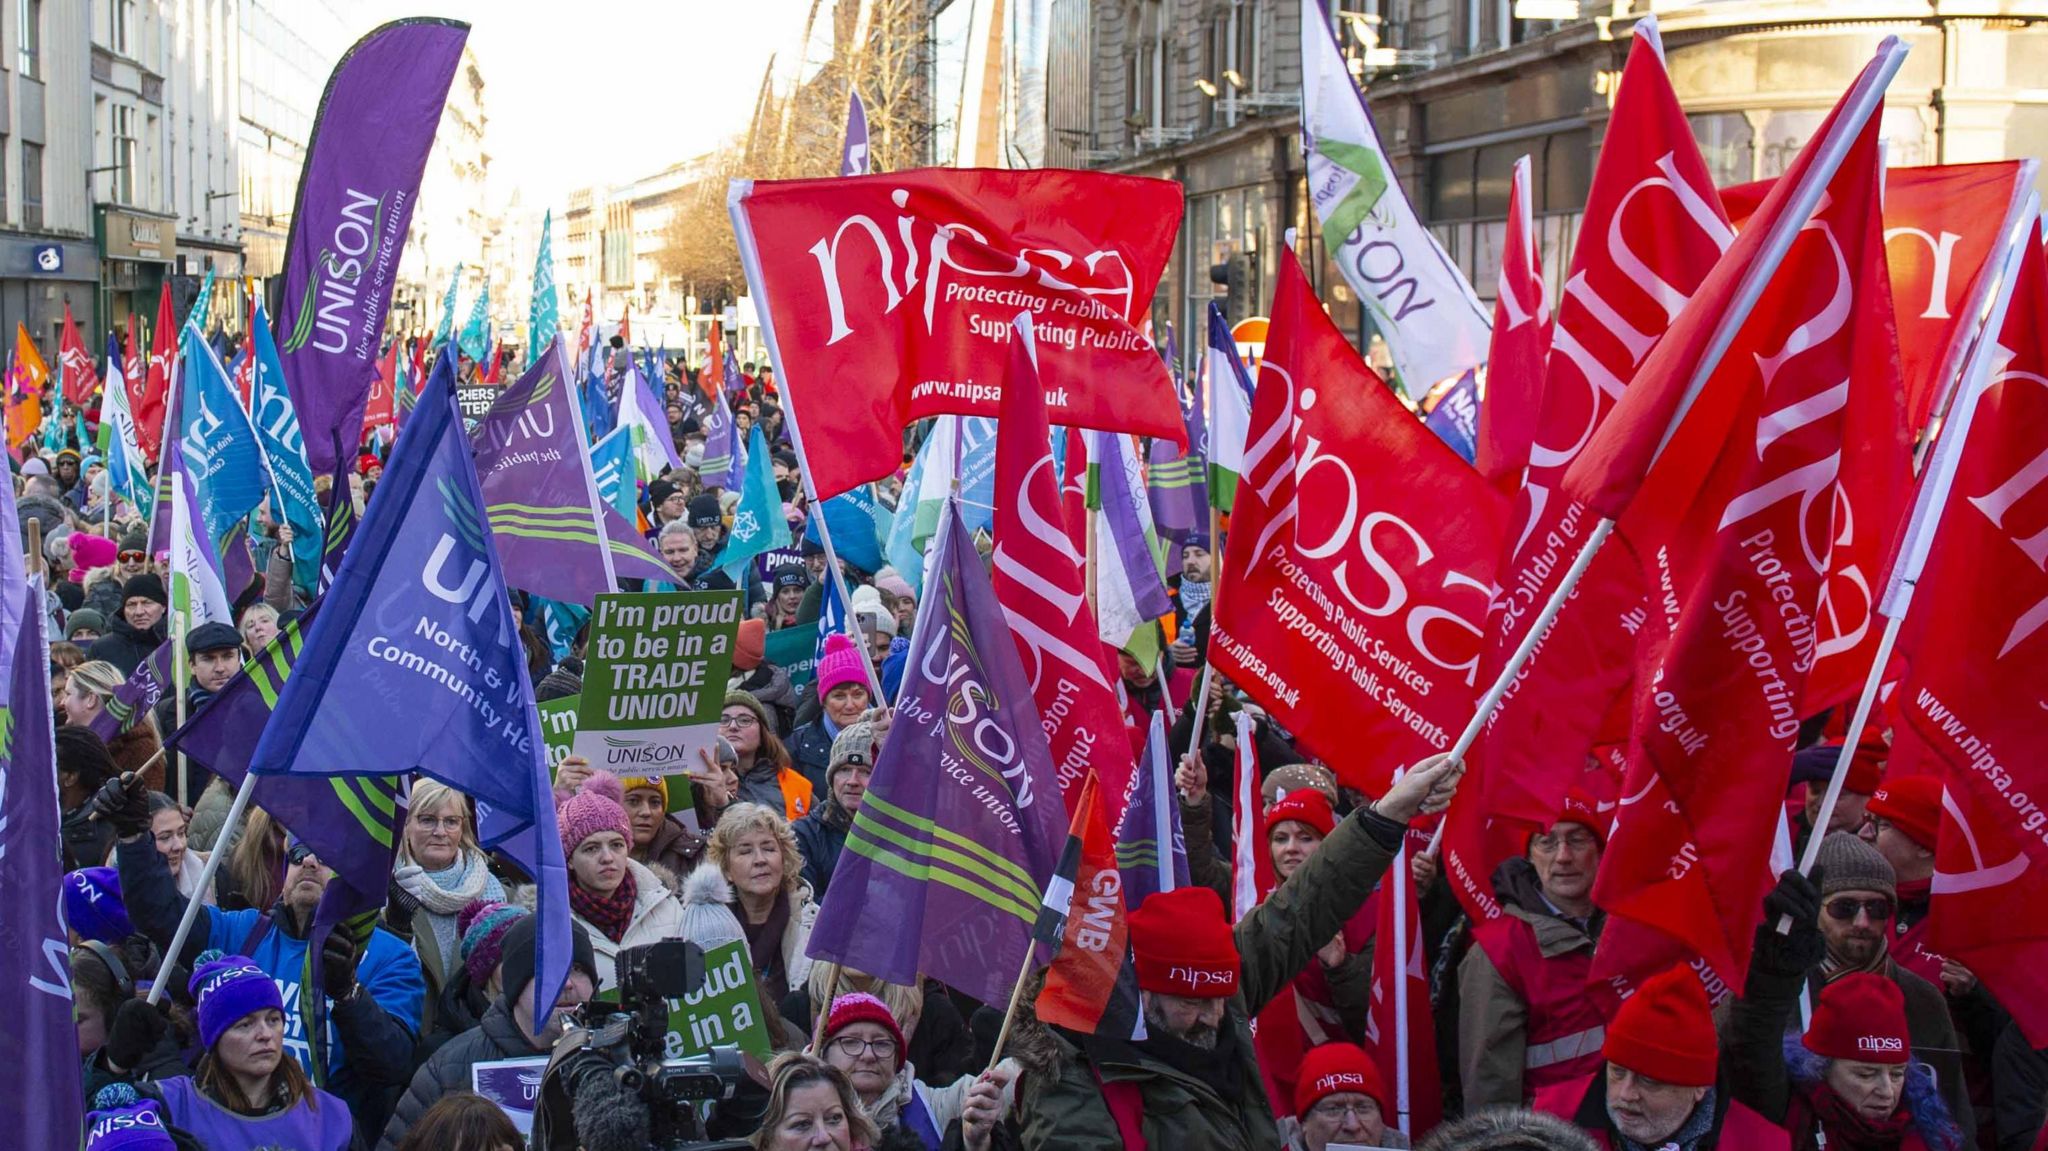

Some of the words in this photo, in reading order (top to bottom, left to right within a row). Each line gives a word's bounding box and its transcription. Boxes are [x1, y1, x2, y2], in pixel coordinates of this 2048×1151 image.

[312, 188, 380, 354] UNISON
[355, 338, 370, 360] the
[363, 289, 381, 337] public
[374, 236, 394, 287] service
[387, 190, 407, 234] union
[945, 282, 1047, 314] Protecting
[1080, 328, 1141, 351] Public
[1241, 360, 1503, 687] nipsa
[598, 601, 644, 627] I’m
[652, 597, 738, 632] proud
[1268, 545, 1334, 629] Protecting
[1334, 606, 1372, 653] Public
[1374, 640, 1434, 696] Services
[1741, 528, 1813, 674] Protecting
[414, 616, 481, 673] North
[484, 667, 503, 688] &
[597, 634, 625, 659] to
[633, 632, 668, 658] be
[676, 631, 703, 656] in
[710, 634, 727, 654] a
[1714, 589, 1801, 740] Supporting
[367, 636, 501, 729] Community
[610, 661, 708, 690] TRADE
[1267, 588, 1344, 669] Supporting
[1345, 652, 1381, 701] Public
[1382, 692, 1450, 750] Servants
[608, 692, 698, 721] UNION
[545, 744, 571, 768] to
[607, 744, 685, 764] UNISON
[900, 695, 933, 724] the
[972, 784, 1023, 835] union
[1169, 966, 1234, 991] nipsa
[688, 1013, 725, 1049] in
[731, 1002, 754, 1032] a
[1857, 1034, 1903, 1053] nipsa
[1316, 1071, 1364, 1092] nipsa
